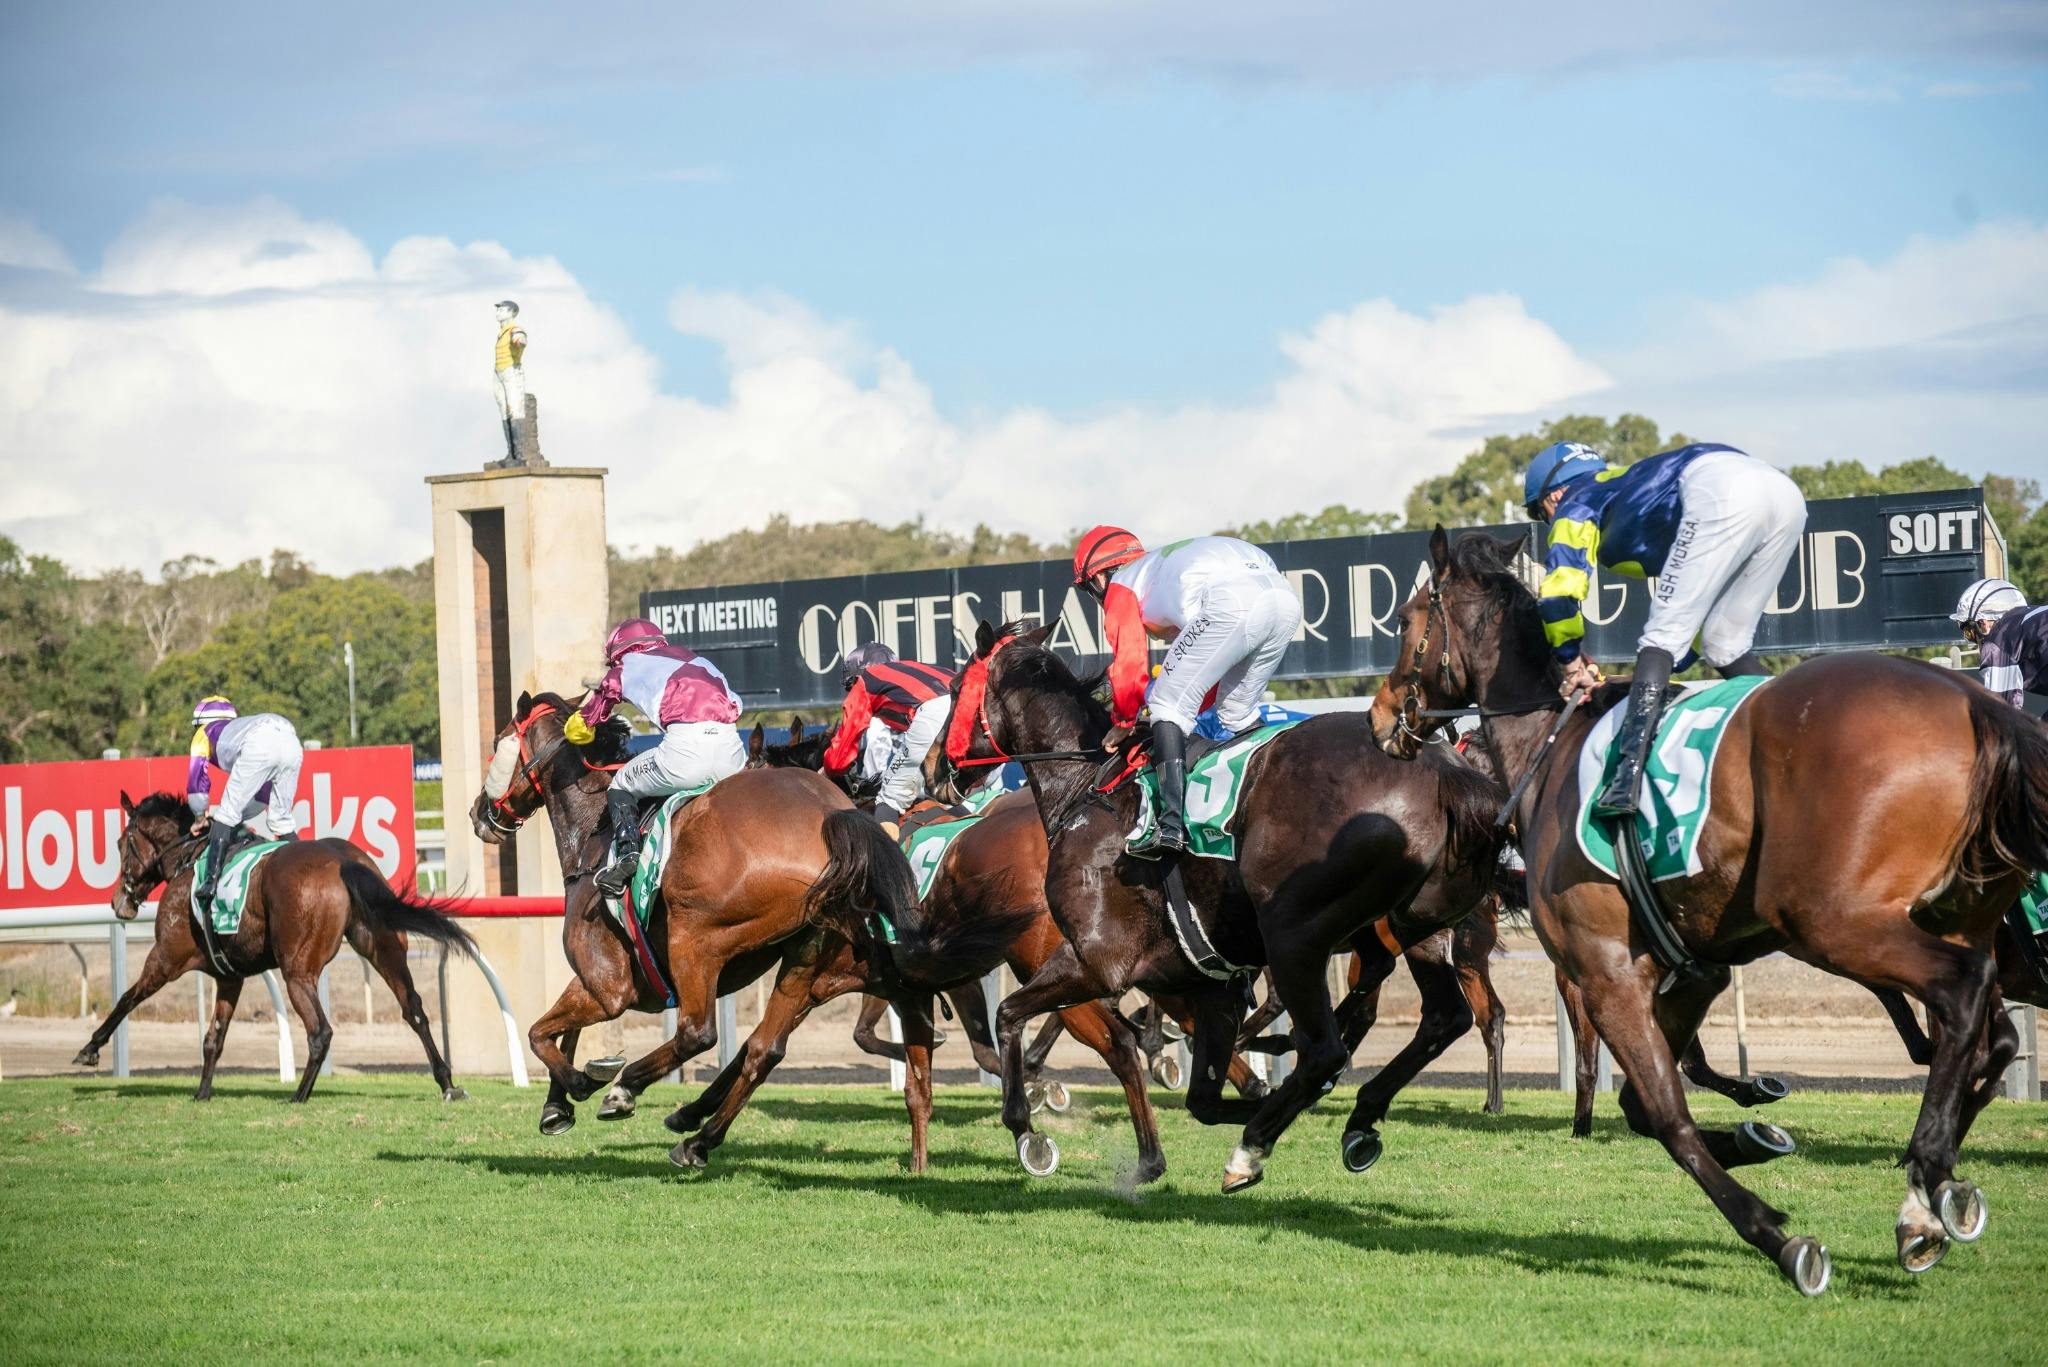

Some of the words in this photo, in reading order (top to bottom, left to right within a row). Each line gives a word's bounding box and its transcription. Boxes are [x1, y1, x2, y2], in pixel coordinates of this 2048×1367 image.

[1889, 510, 1978, 555] SOFT
[1657, 573, 1679, 604] ASH
[1670, 519, 1699, 570] MORGA
[649, 603, 695, 635] NEXT
[699, 597, 778, 633] MEETING
[1174, 616, 1211, 661] SPOKES
[1656, 706, 1727, 817] 5
[216, 852, 257, 912] 4
